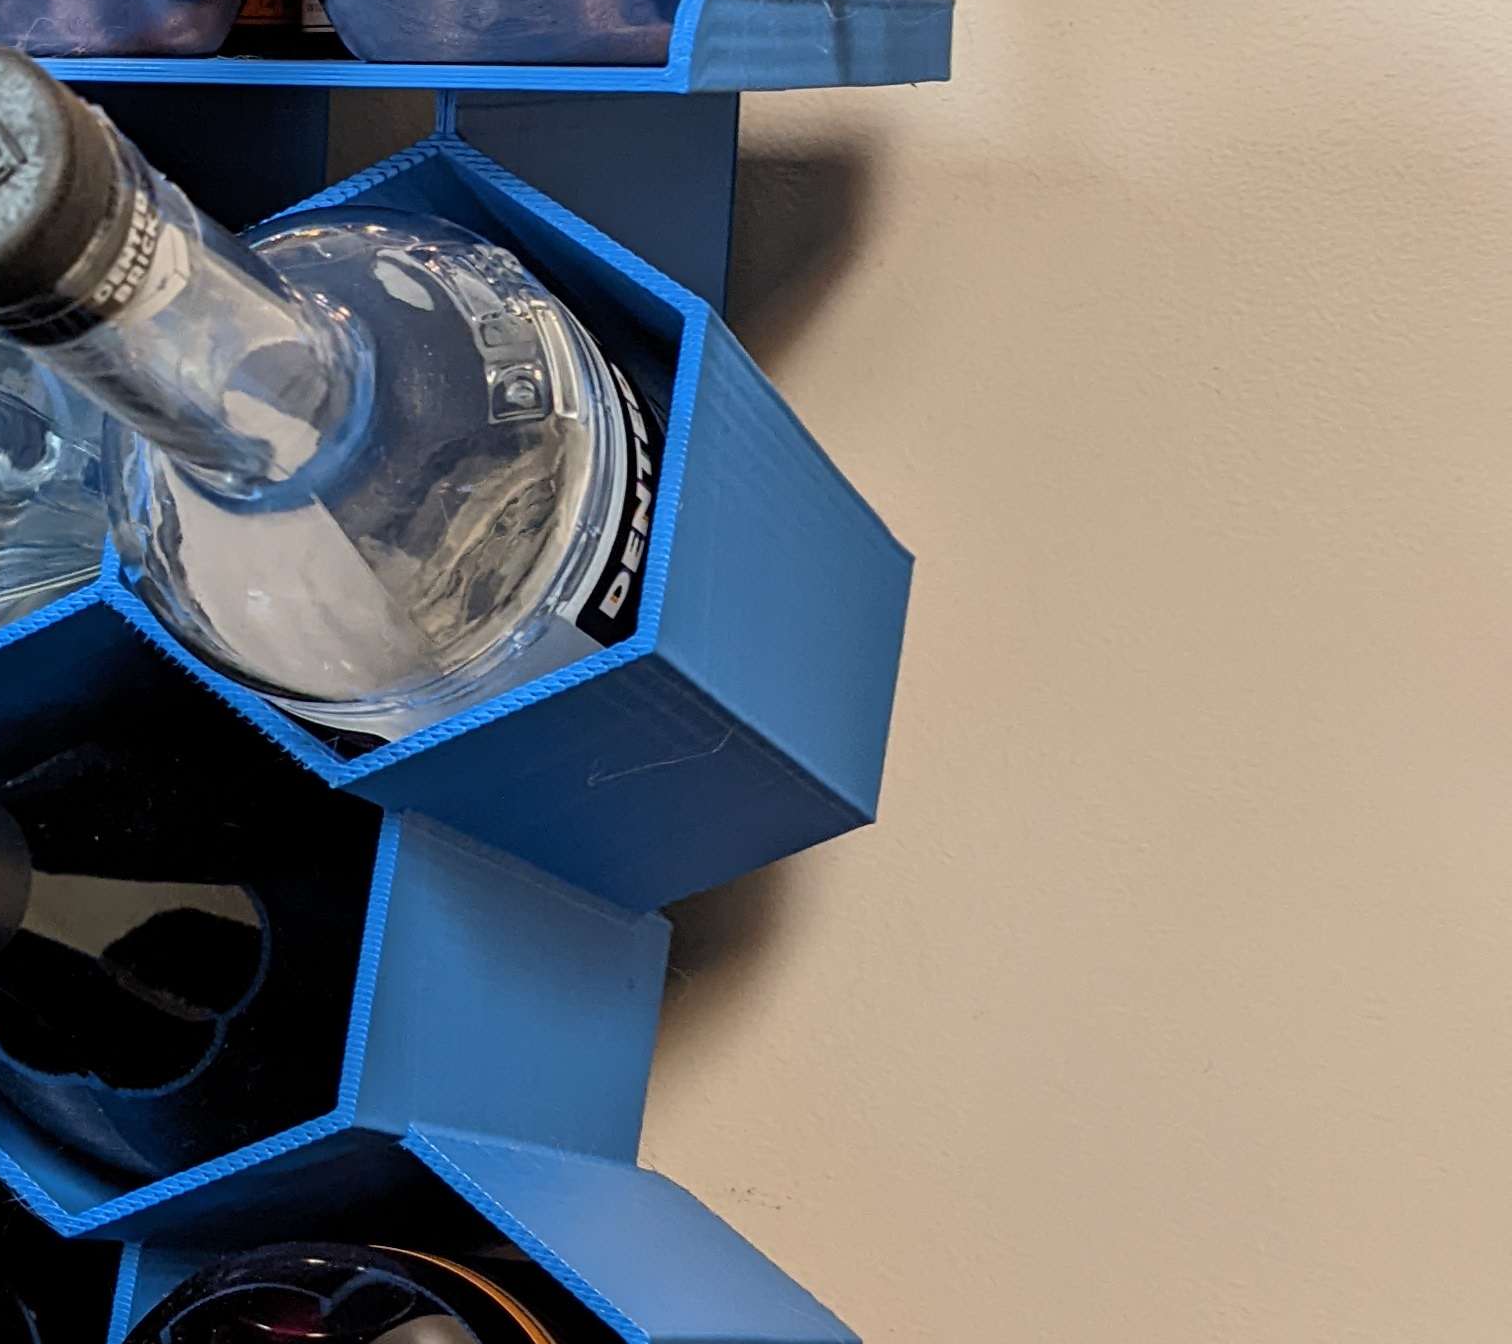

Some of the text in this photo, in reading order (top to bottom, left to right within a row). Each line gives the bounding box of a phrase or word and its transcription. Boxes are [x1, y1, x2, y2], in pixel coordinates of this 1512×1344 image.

[93, 190, 148, 304] DENTED
[113, 212, 159, 303] BRICK
[598, 361, 652, 620] DENTED
